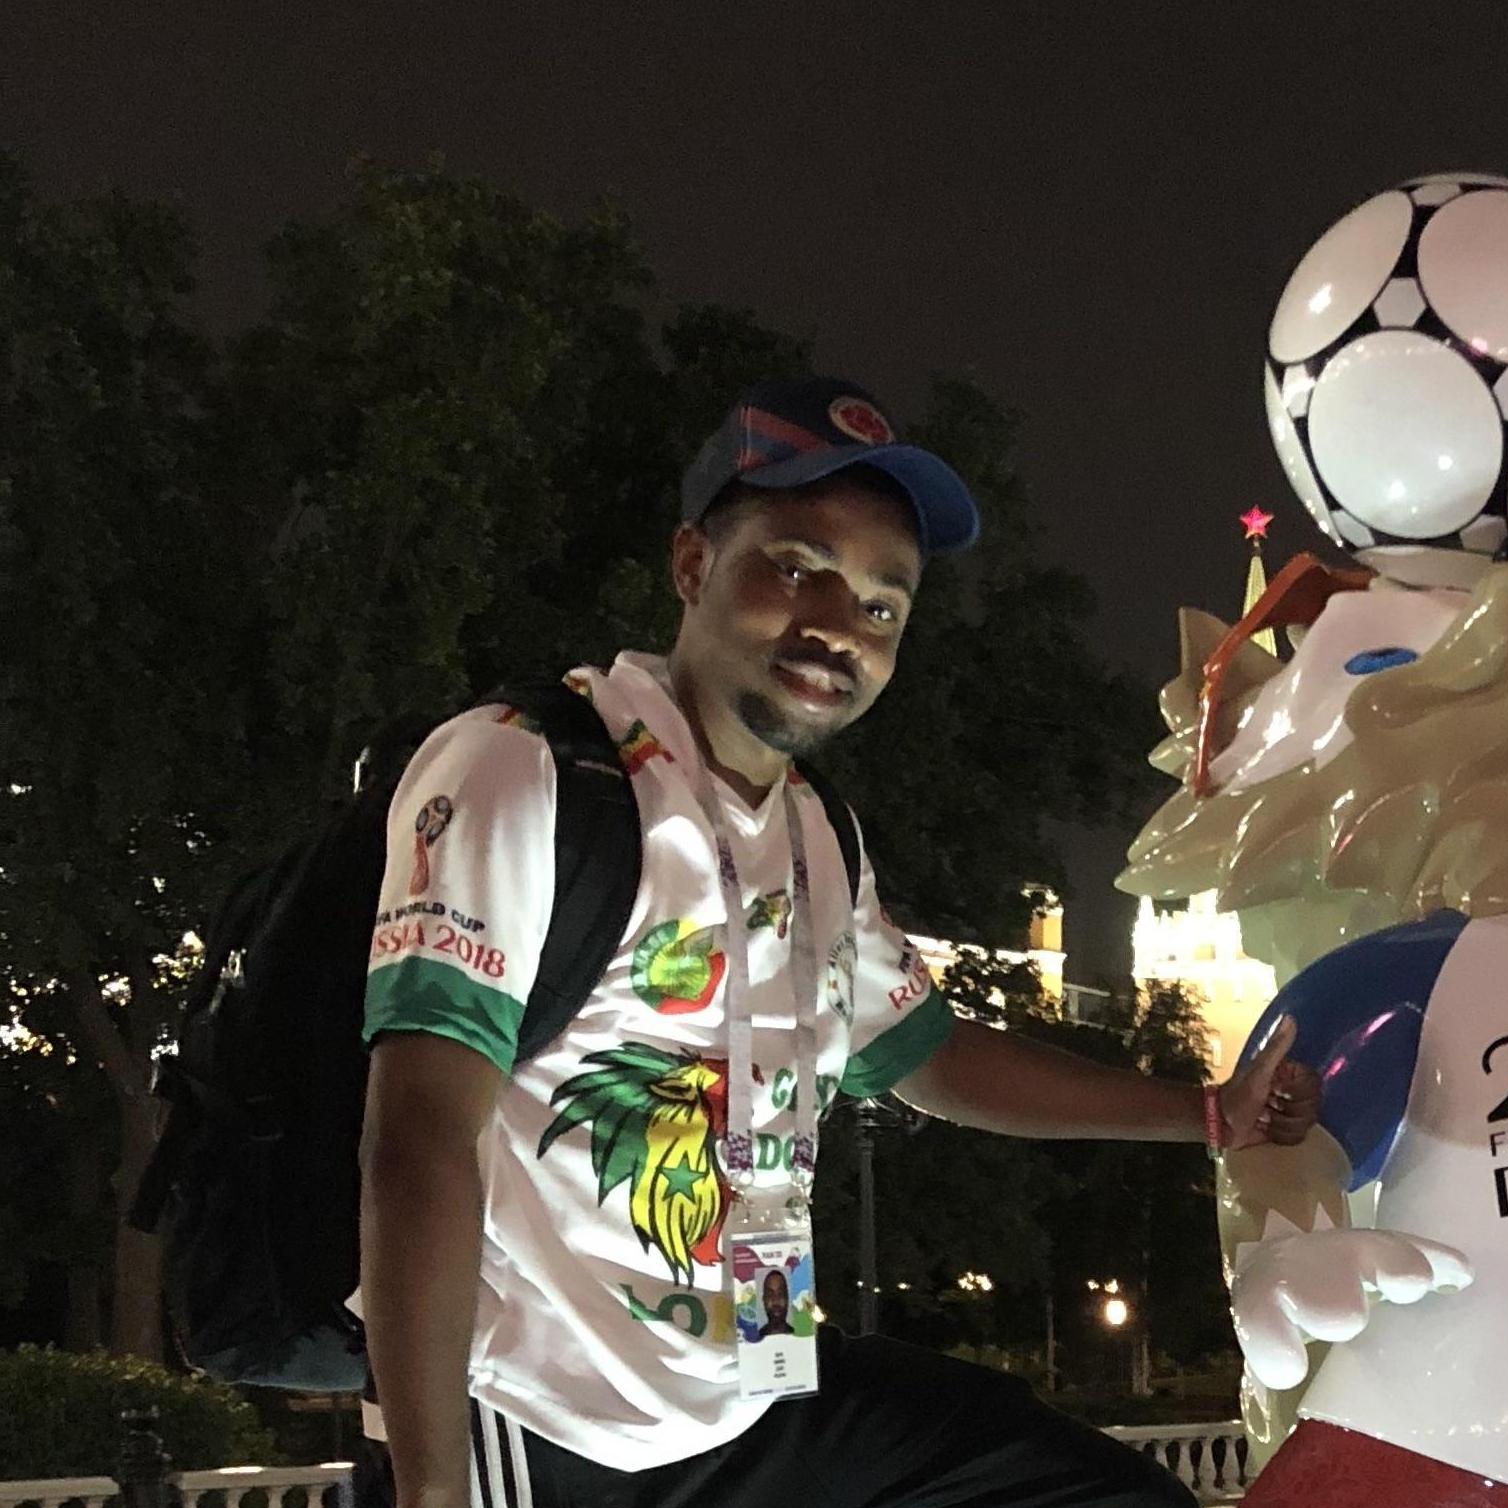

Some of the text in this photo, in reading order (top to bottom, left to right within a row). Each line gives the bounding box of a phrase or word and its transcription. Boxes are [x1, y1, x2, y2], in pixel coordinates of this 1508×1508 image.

[451, 909, 486, 933] CUP
[373, 920, 506, 978] SSIA 2018
